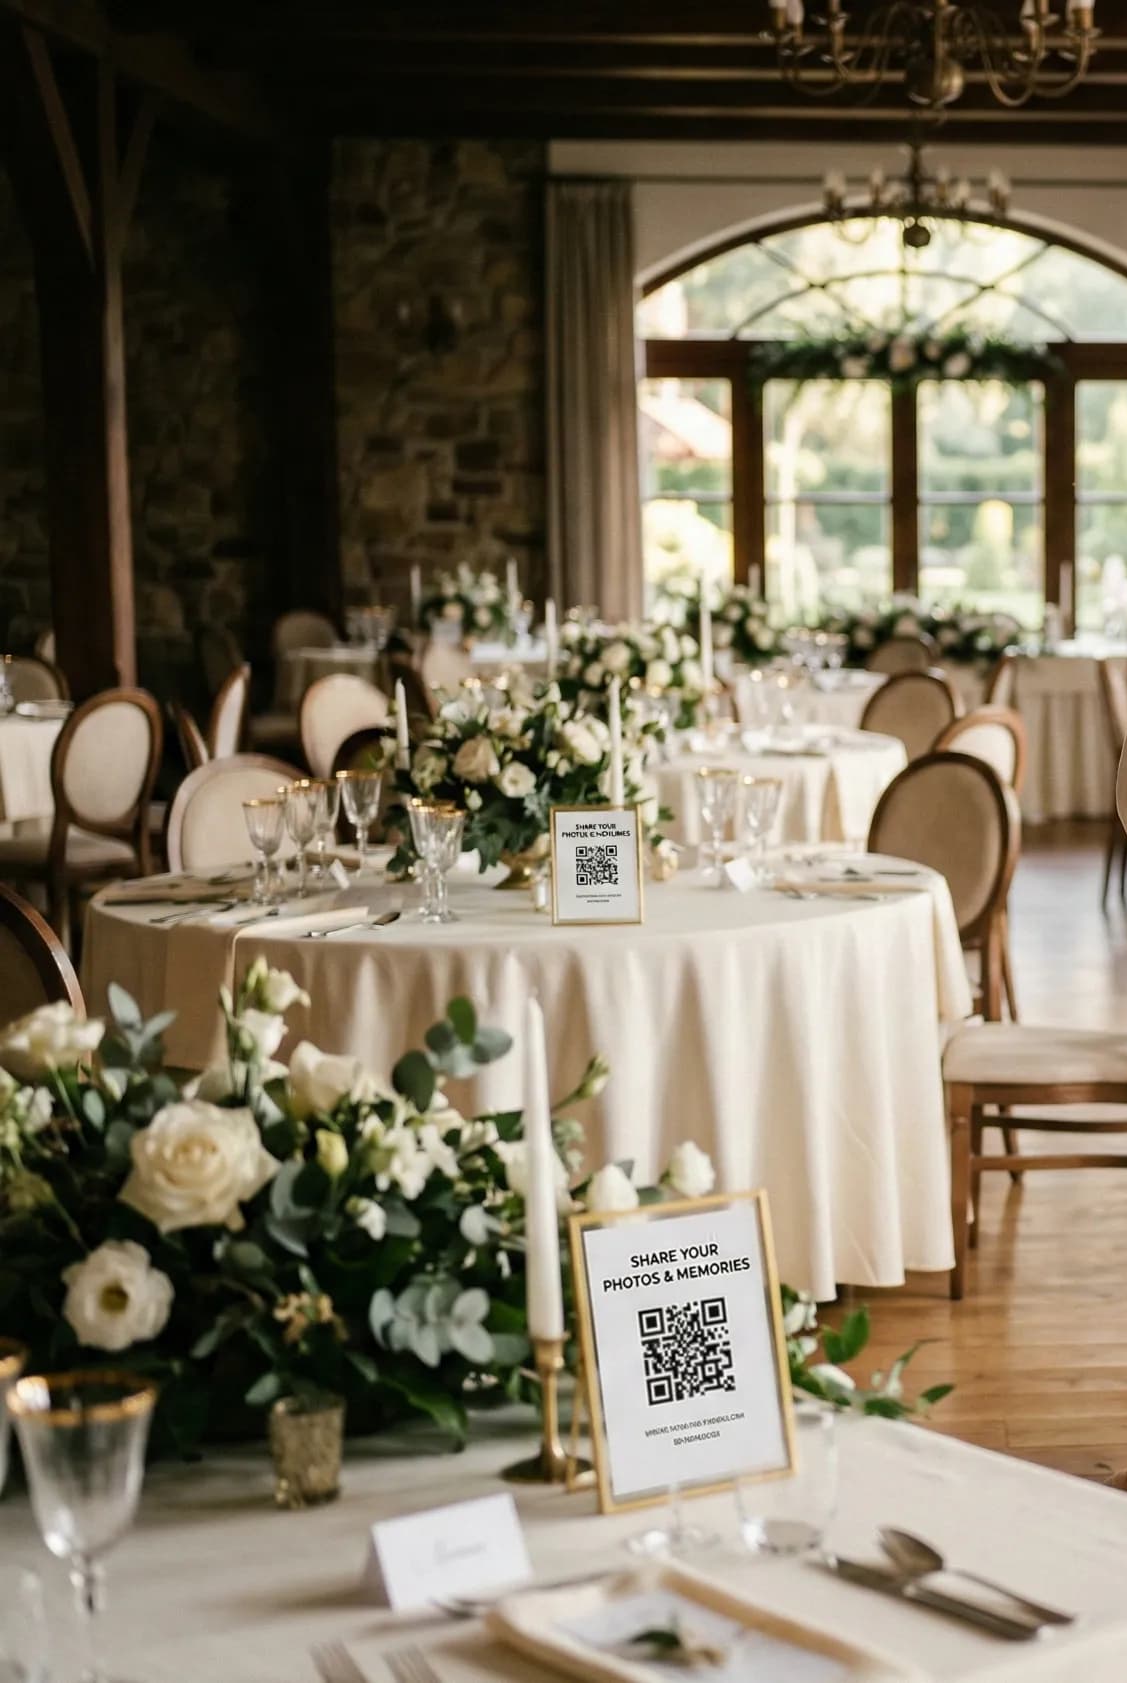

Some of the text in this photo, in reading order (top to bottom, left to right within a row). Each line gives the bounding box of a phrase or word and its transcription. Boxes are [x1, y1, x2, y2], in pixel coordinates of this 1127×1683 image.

[630, 1243, 719, 1268] SHARE YOUR
[603, 1257, 751, 1292] PHOTOS & MEMORIES
